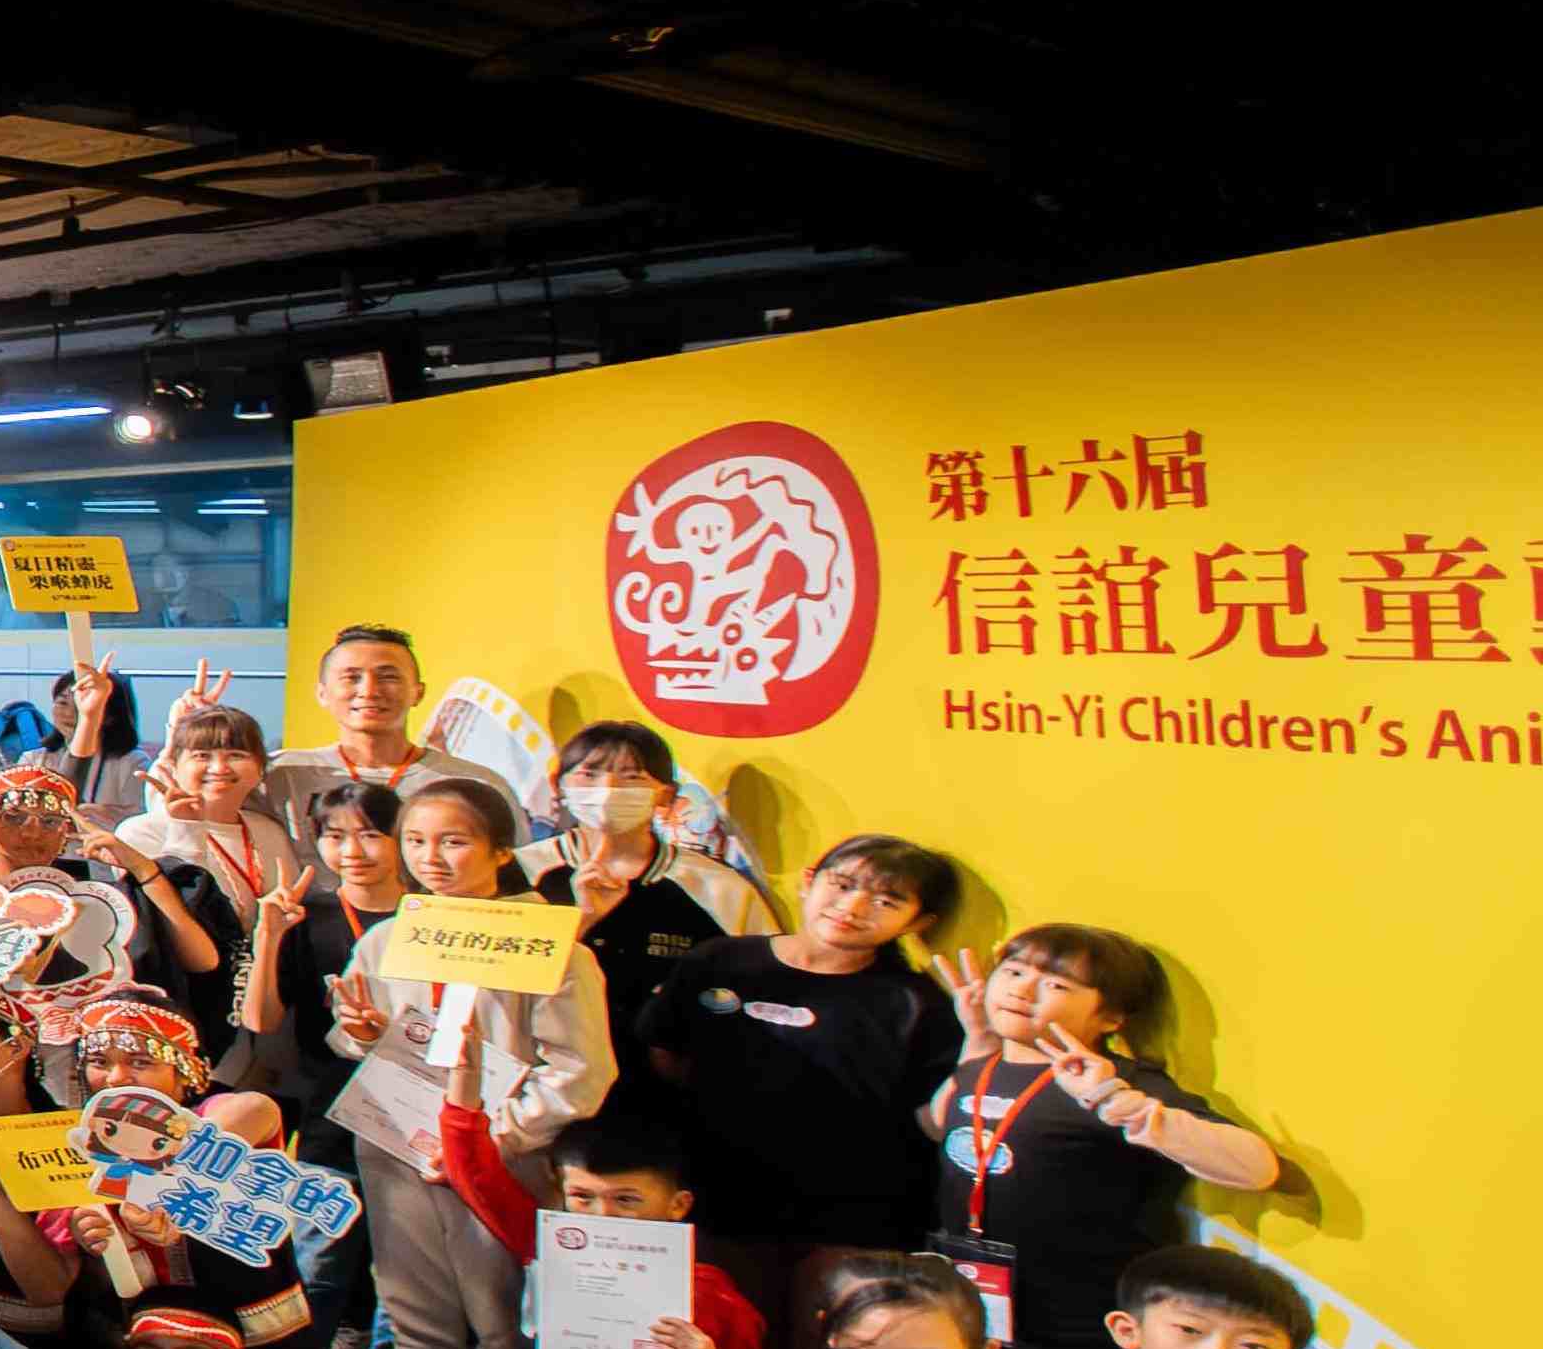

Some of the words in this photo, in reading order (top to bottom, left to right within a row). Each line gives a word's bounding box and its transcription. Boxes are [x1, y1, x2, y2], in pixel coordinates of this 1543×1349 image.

[927, 430, 1209, 523] 第十六屆
[943, 689, 1107, 740] Hsin-Yi
[409, 925, 556, 957] 美好的露營
[158, 1182, 285, 1265] 希望
